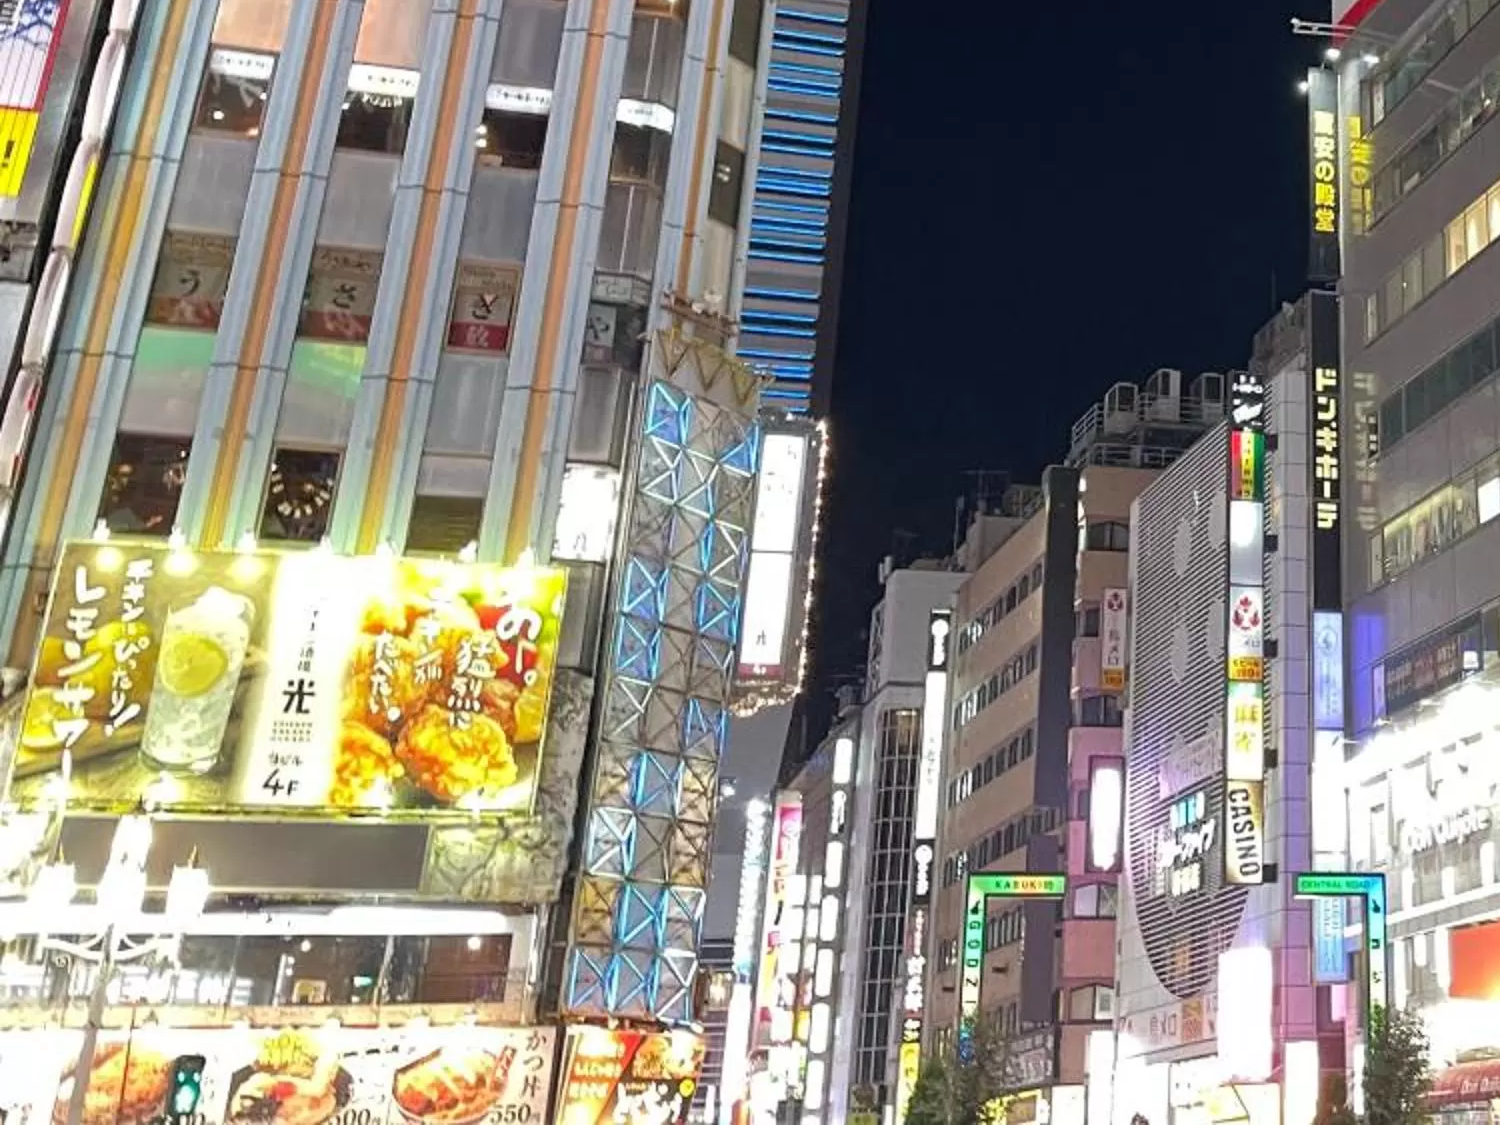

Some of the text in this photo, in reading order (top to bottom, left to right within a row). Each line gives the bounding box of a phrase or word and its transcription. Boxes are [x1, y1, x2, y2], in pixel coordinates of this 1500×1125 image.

[52, 565, 107, 781] レモンサワー
[282, 678, 316, 714] 光
[262, 768, 299, 797] 4F
[1227, 786, 1260, 877] CASINO
